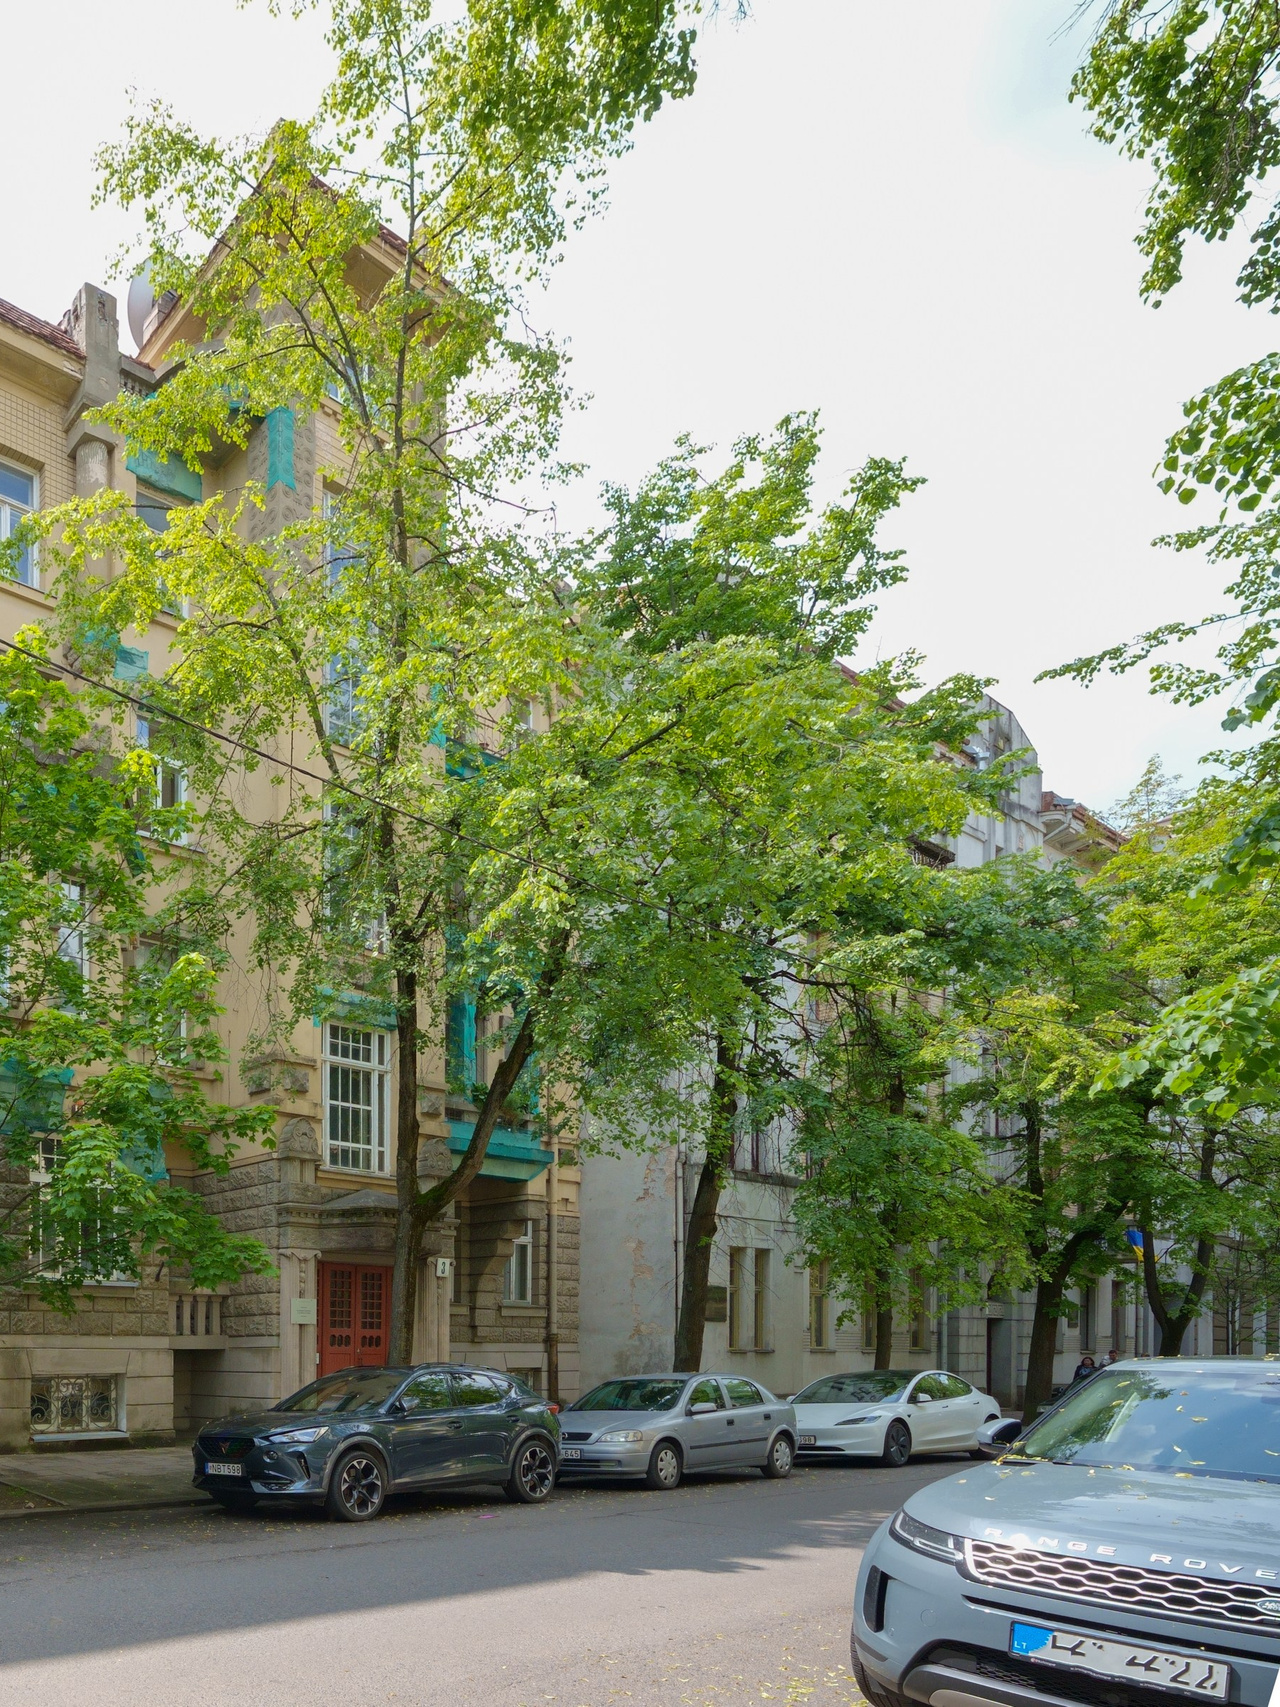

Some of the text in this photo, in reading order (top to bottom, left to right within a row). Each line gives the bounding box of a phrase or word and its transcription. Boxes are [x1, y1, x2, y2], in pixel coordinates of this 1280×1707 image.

[441, 1261, 446, 1275] 3
[211, 1464, 241, 1475] NBT598
[984, 1527, 1118, 1556] RNGE
[1014, 1640, 1027, 1649] LT
